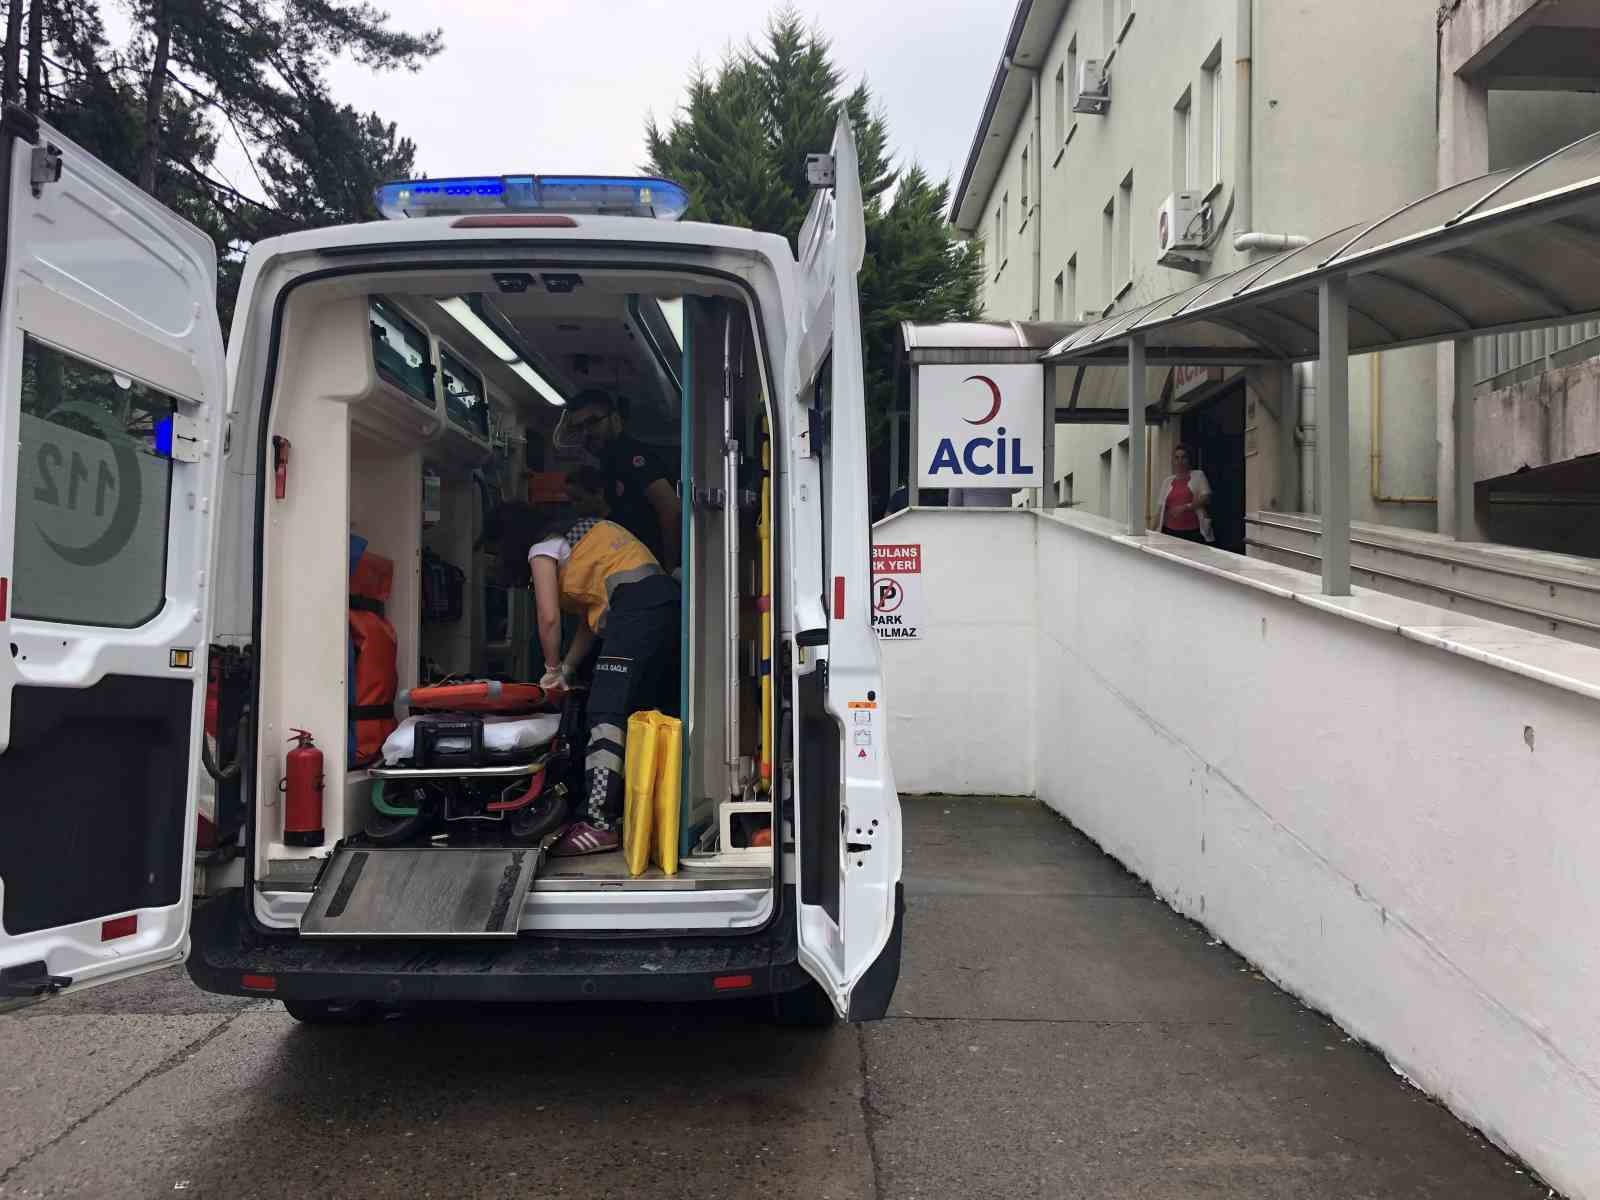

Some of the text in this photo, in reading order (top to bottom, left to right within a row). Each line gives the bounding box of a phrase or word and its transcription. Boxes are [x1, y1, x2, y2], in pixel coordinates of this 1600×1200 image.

[928, 426, 1034, 475] ACİL
[888, 559, 917, 571] YERİ
[872, 615, 903, 625] PARK
